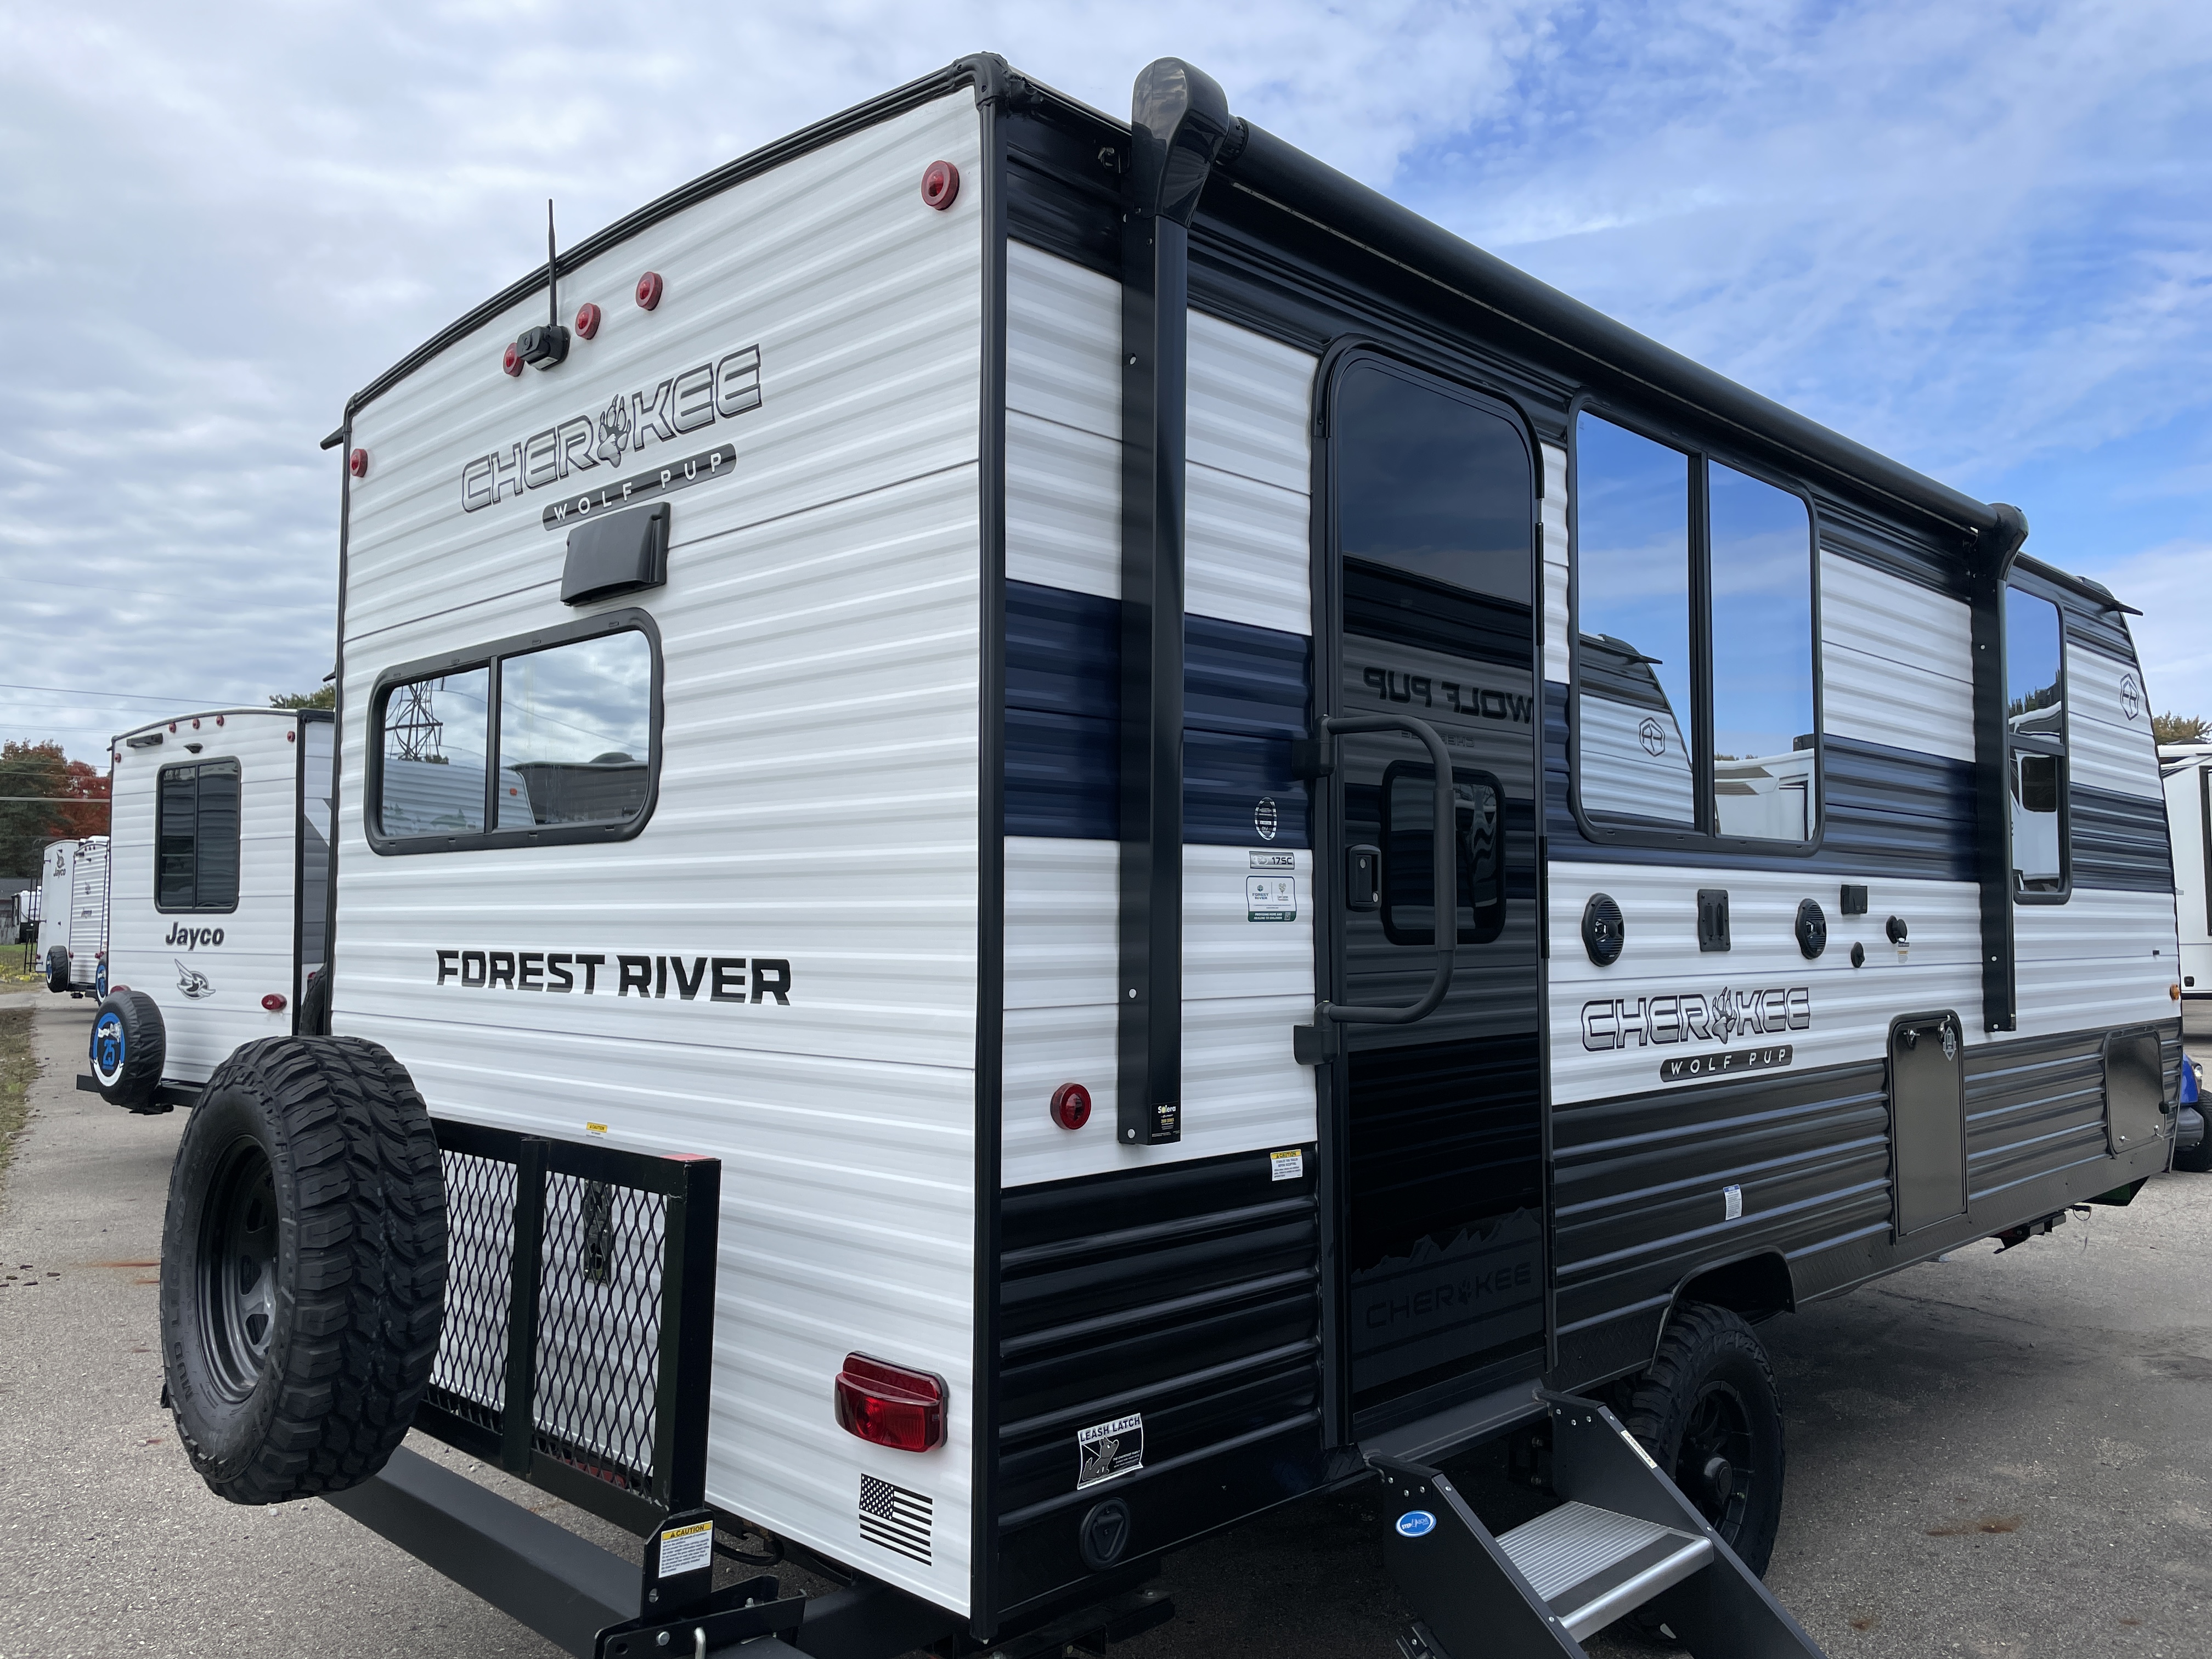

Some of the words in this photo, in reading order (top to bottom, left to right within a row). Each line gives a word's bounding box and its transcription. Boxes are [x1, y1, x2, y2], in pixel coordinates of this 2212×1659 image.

[554, 482, 634, 522] WOLF
[661, 452, 723, 489] PUP
[166, 922, 225, 951] Jayco
[436, 950, 605, 995] FOREST
[617, 955, 791, 1006] RIVER
[1671, 1055, 1733, 1076] WOLF
[1748, 1048, 1787, 1066] PUP
[1158, 1105, 1176, 1113] Solera
[1080, 1426, 1109, 1442] LEASH
[1112, 1417, 1140, 1432] LATCH
[676, 1525, 704, 1537] CAUTION
